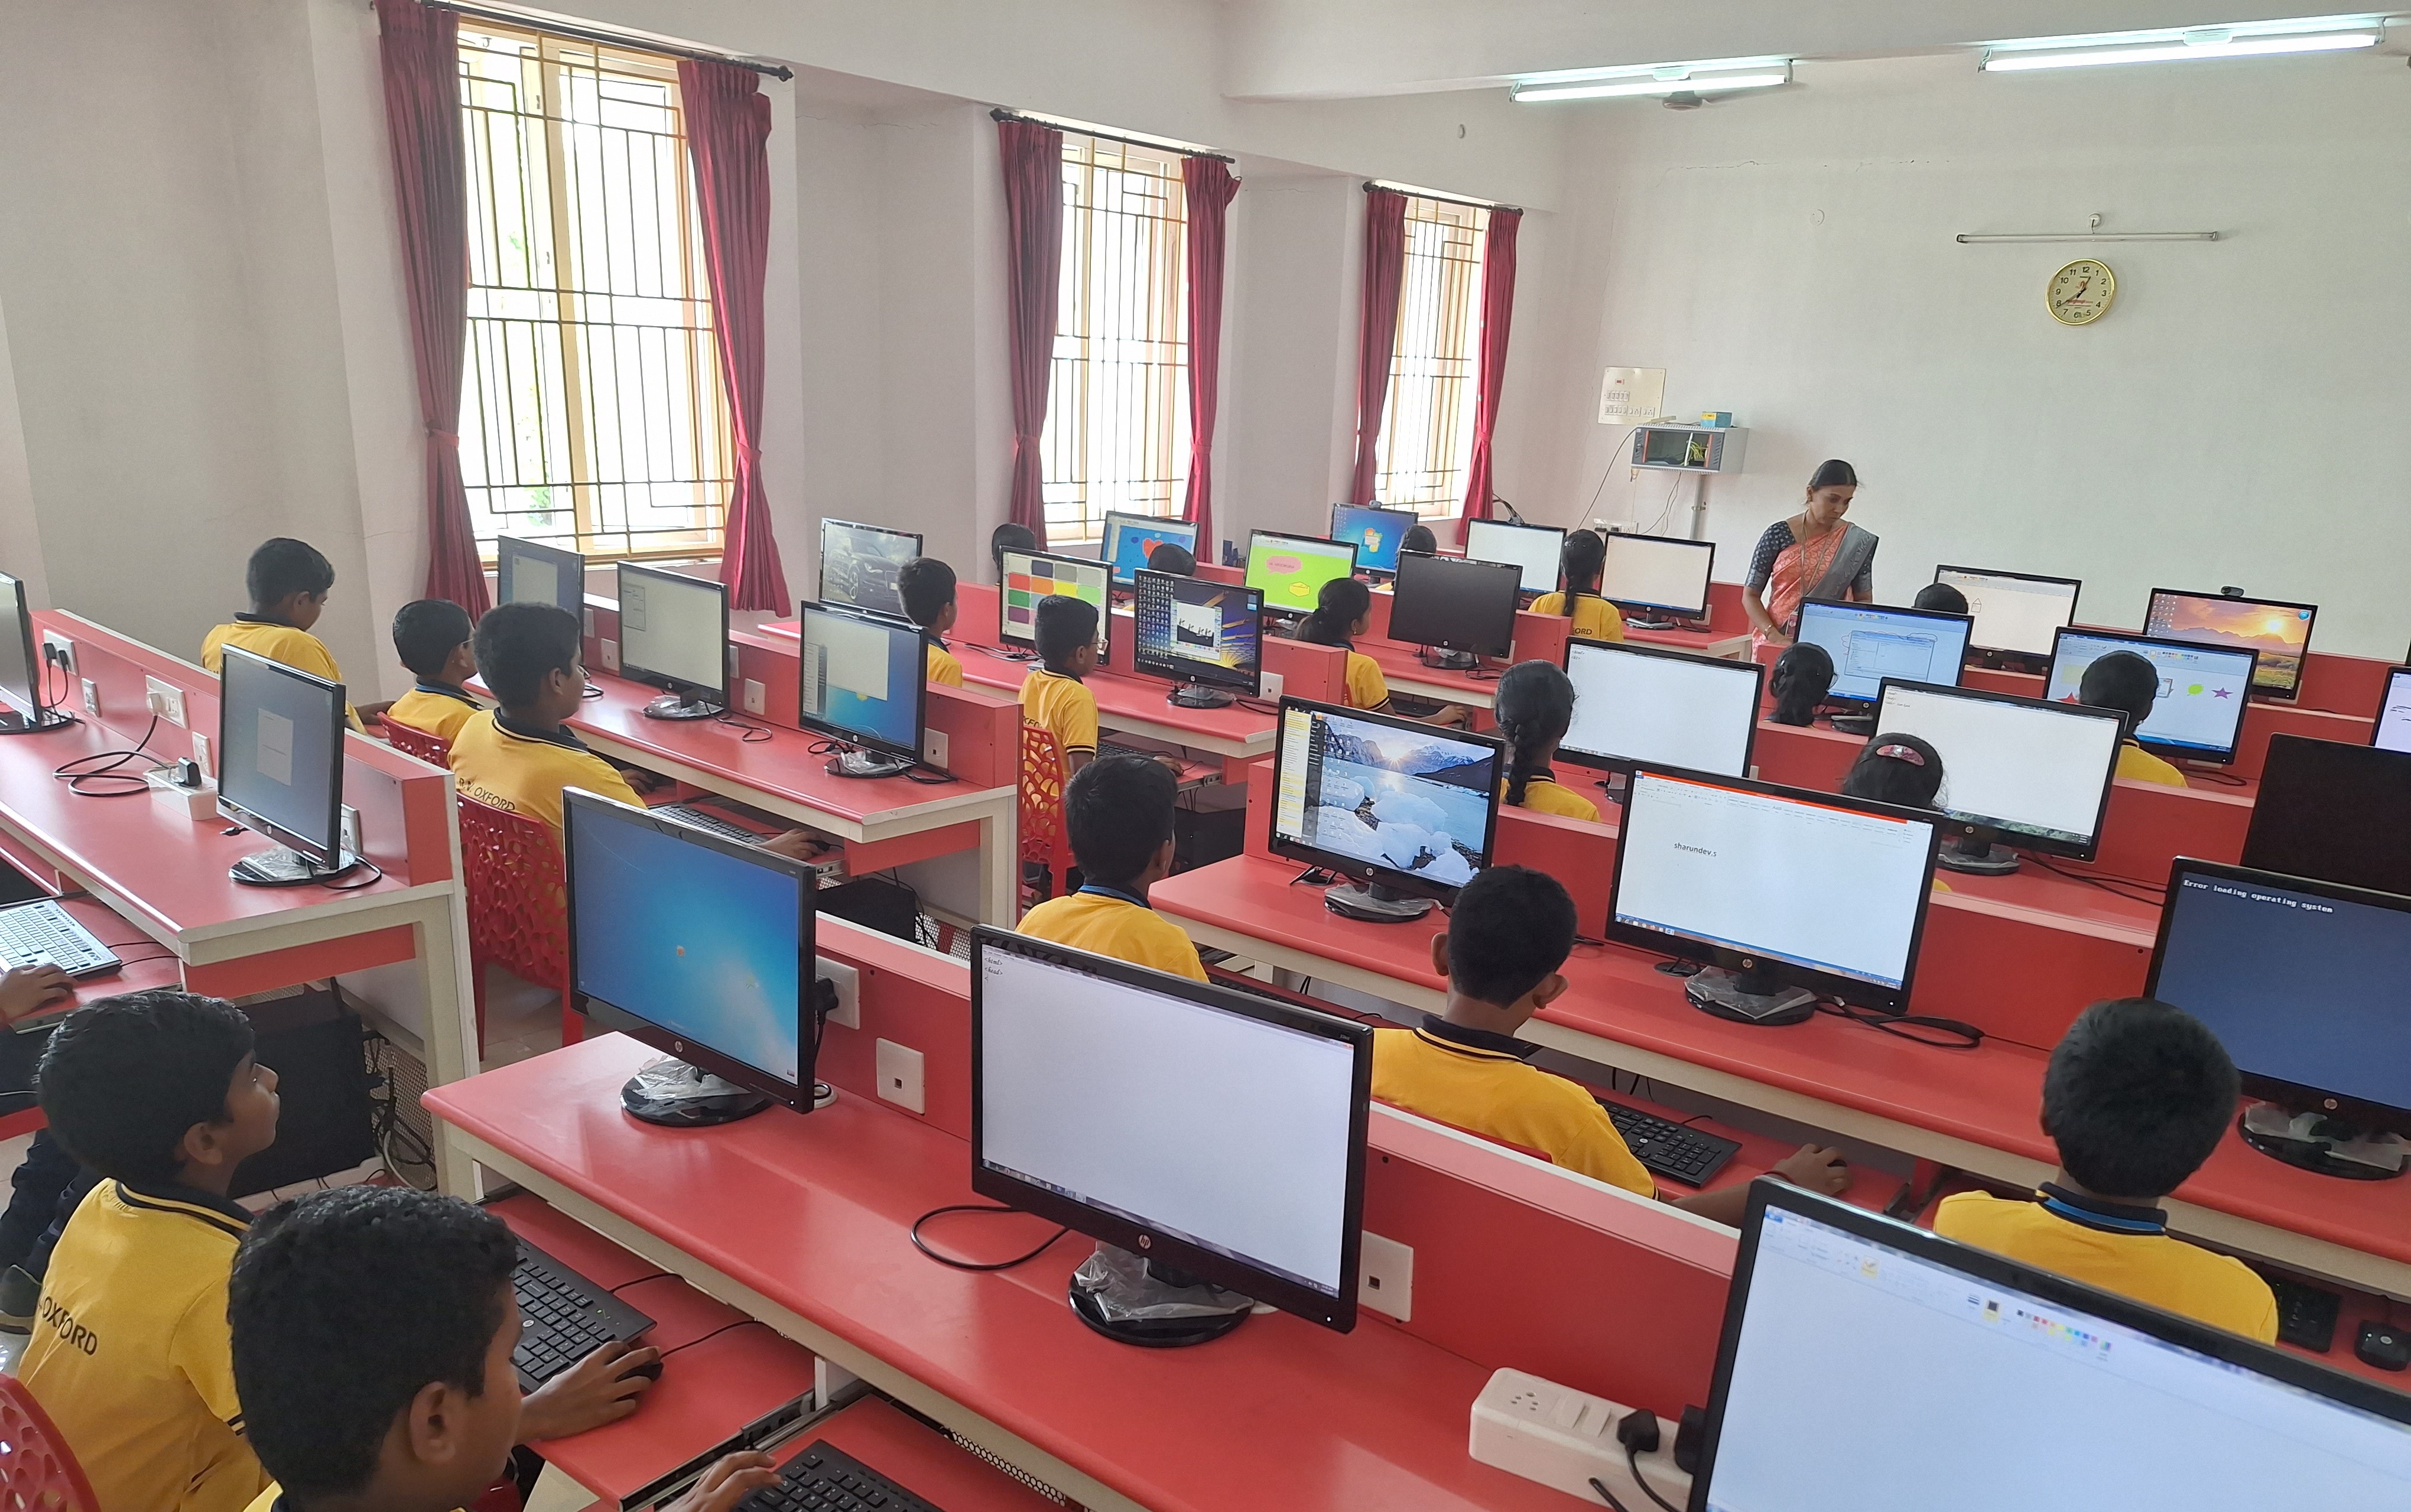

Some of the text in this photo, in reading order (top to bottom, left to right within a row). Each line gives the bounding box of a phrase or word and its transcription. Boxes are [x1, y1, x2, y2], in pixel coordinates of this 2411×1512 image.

[474, 786, 515, 811] OXFORD
[1366, 867, 1374, 877] hp
[2183, 879, 2333, 913] Error loading operating system
[984, 957, 1003, 965] <html>
[1742, 959, 1753, 968] hp
[984, 967, 1003, 976] <head>
[1139, 1234, 1152, 1250] hp
[42, 1296, 98, 1355] OXFORD
